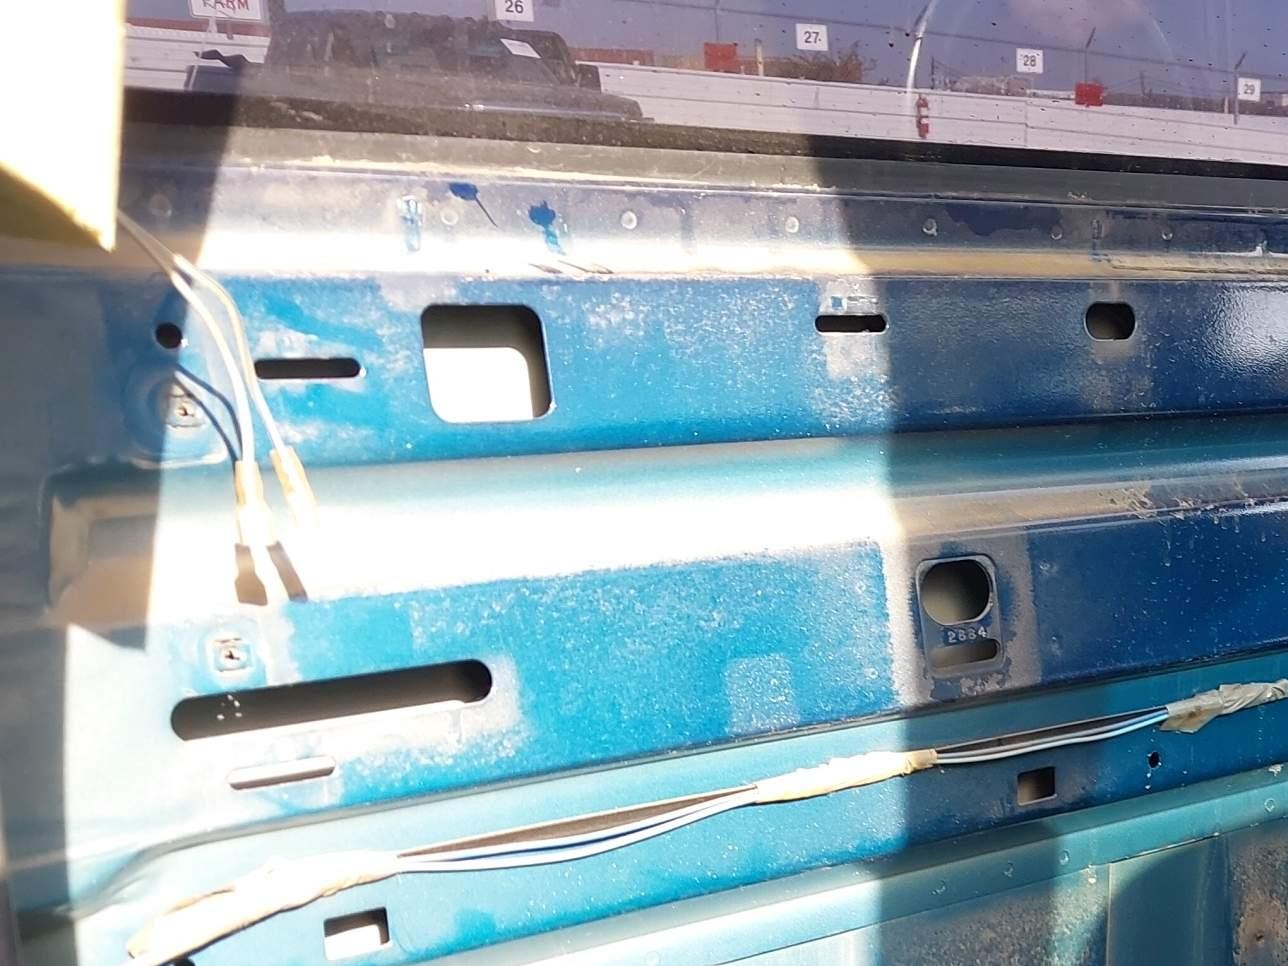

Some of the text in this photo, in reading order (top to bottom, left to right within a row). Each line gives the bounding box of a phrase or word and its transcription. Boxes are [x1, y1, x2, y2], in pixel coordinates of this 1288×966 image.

[504, 0, 524, 14] 26
[803, 30, 820, 44] 27
[1023, 54, 1037, 67] 28
[947, 626, 987, 643] 2664
